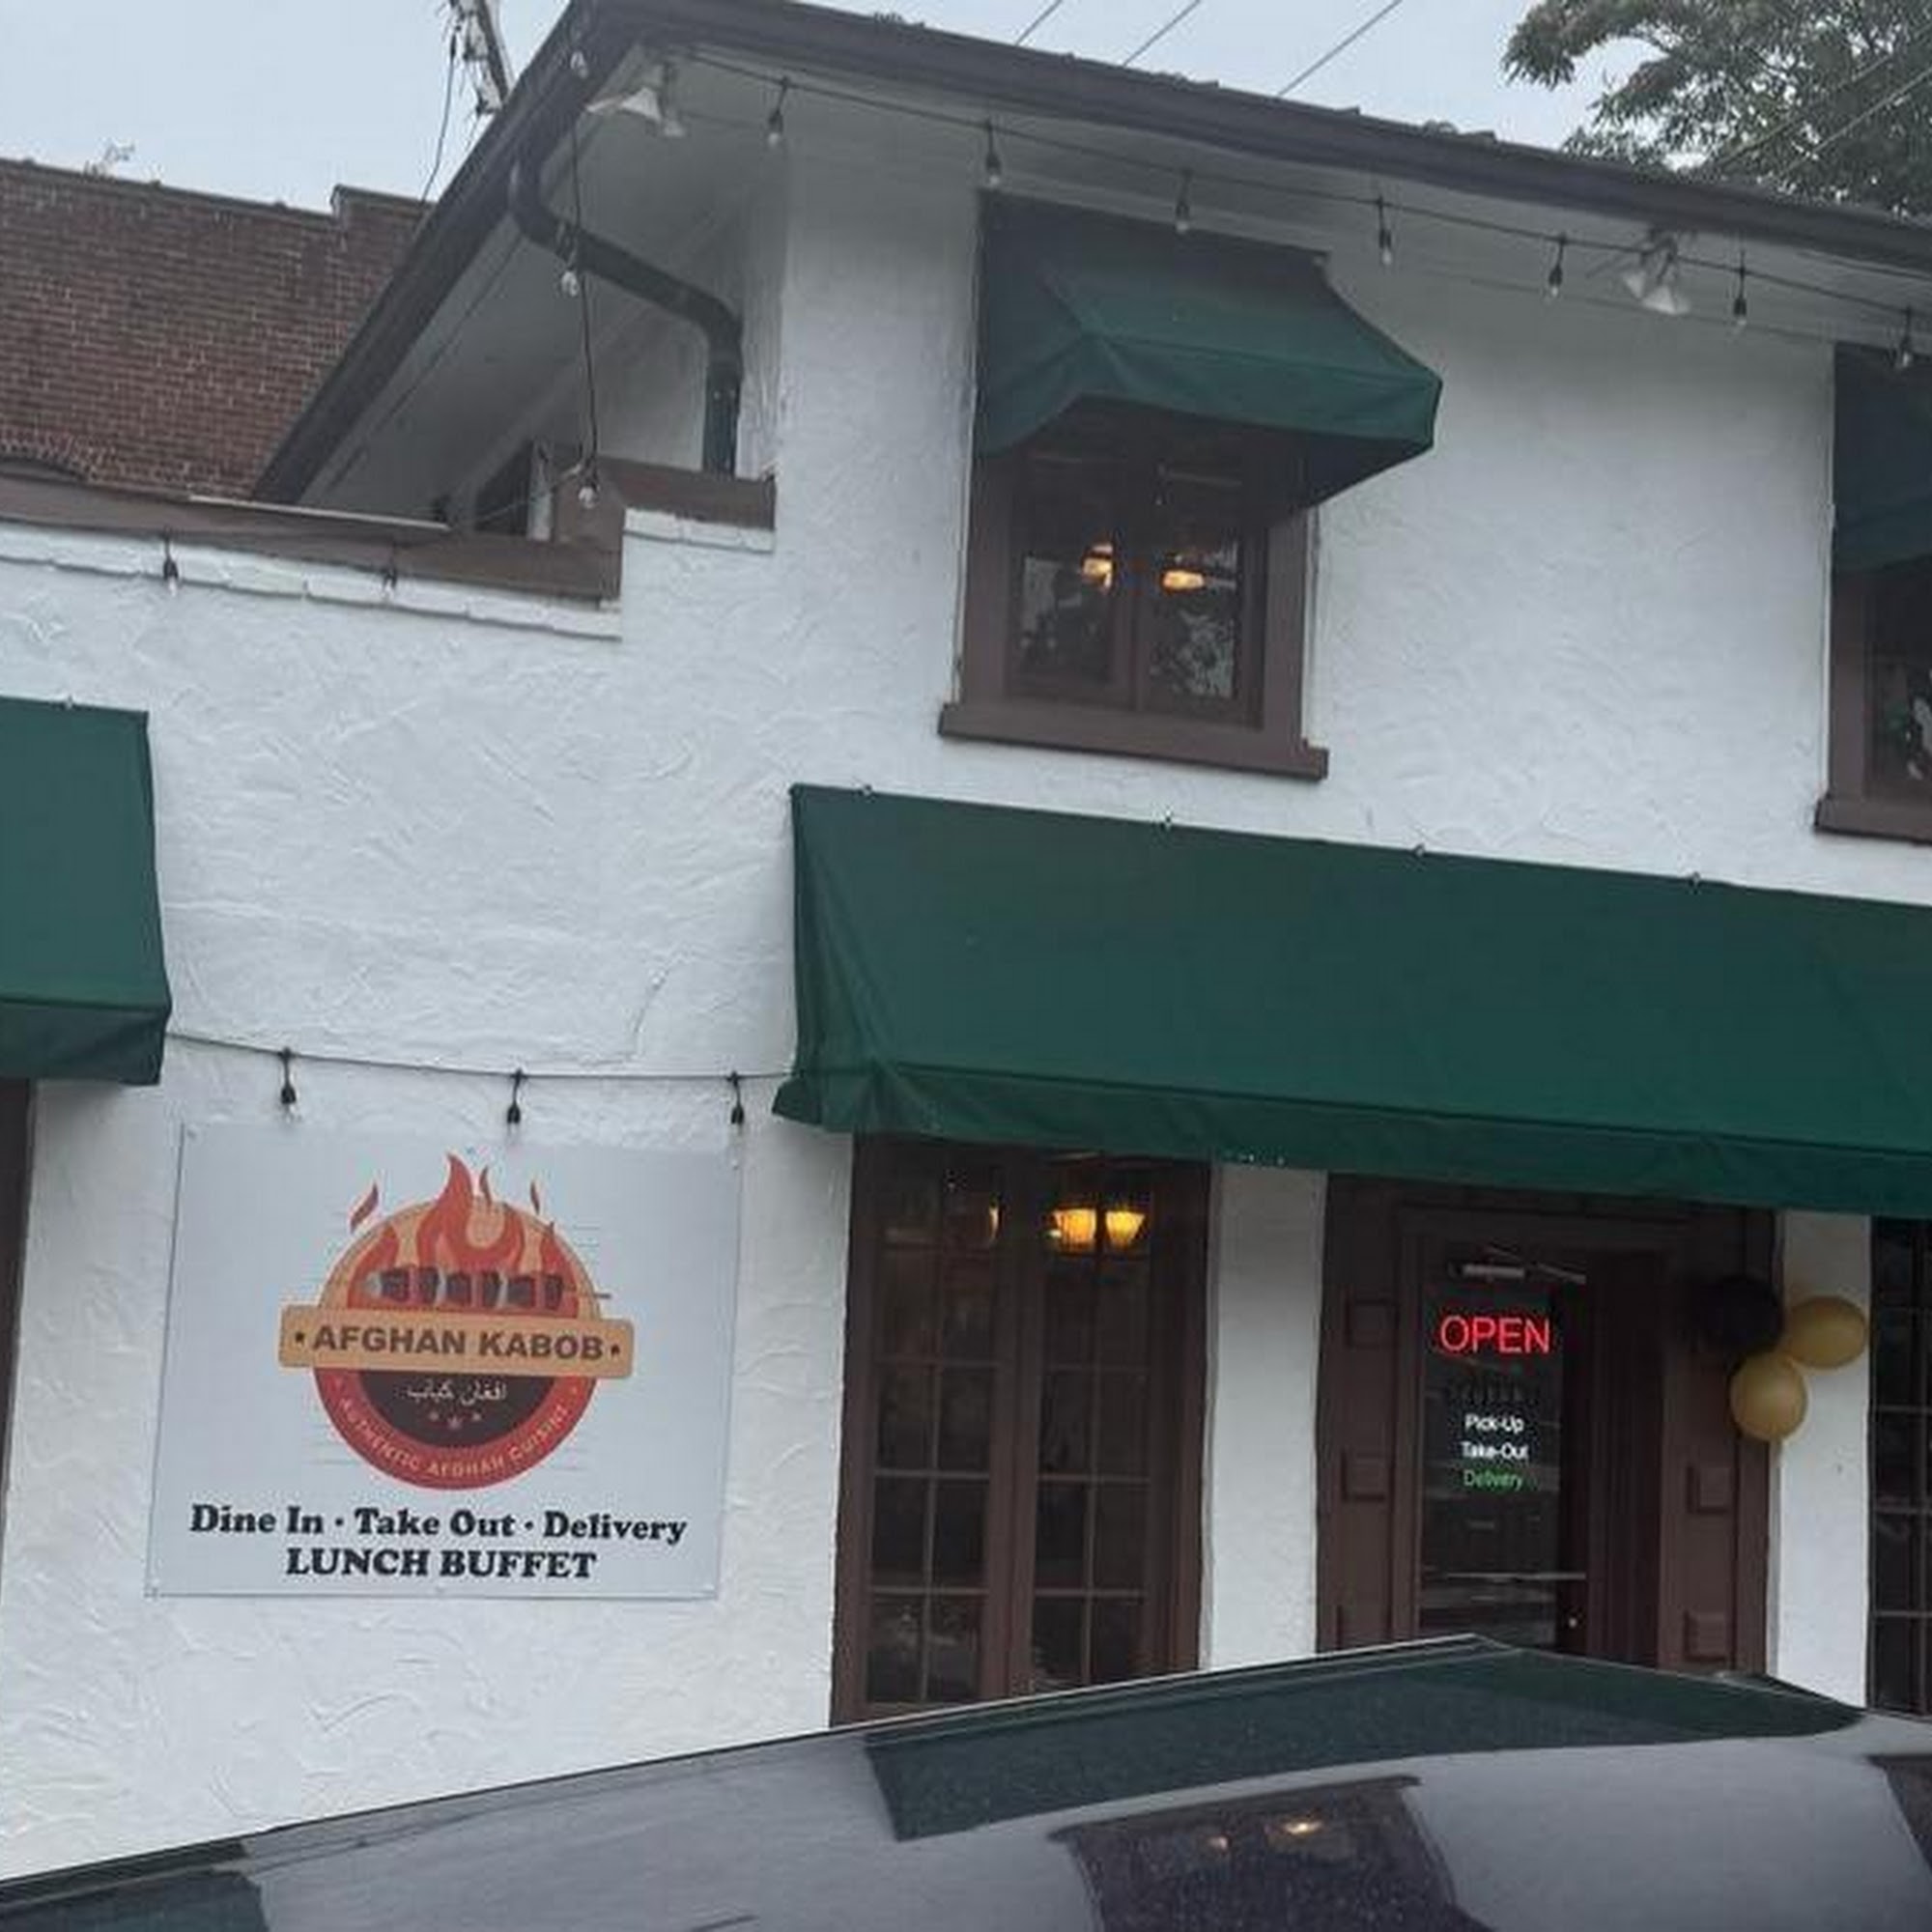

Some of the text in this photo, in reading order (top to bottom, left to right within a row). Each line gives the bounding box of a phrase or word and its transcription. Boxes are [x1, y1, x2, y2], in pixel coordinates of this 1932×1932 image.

[313, 1325, 605, 1361] AFGHAN KABOB
[1439, 1315, 1550, 1353] OPEN
[1463, 1413, 1525, 1435] Pick-Up
[1461, 1440, 1530, 1461] Take-Out
[429, 1454, 505, 1478] AFGHAN
[1463, 1468, 1522, 1491] Delivery
[189, 1503, 688, 1546] Dine In Take Out Delivery
[286, 1548, 597, 1577] LUNCH BUFFET
